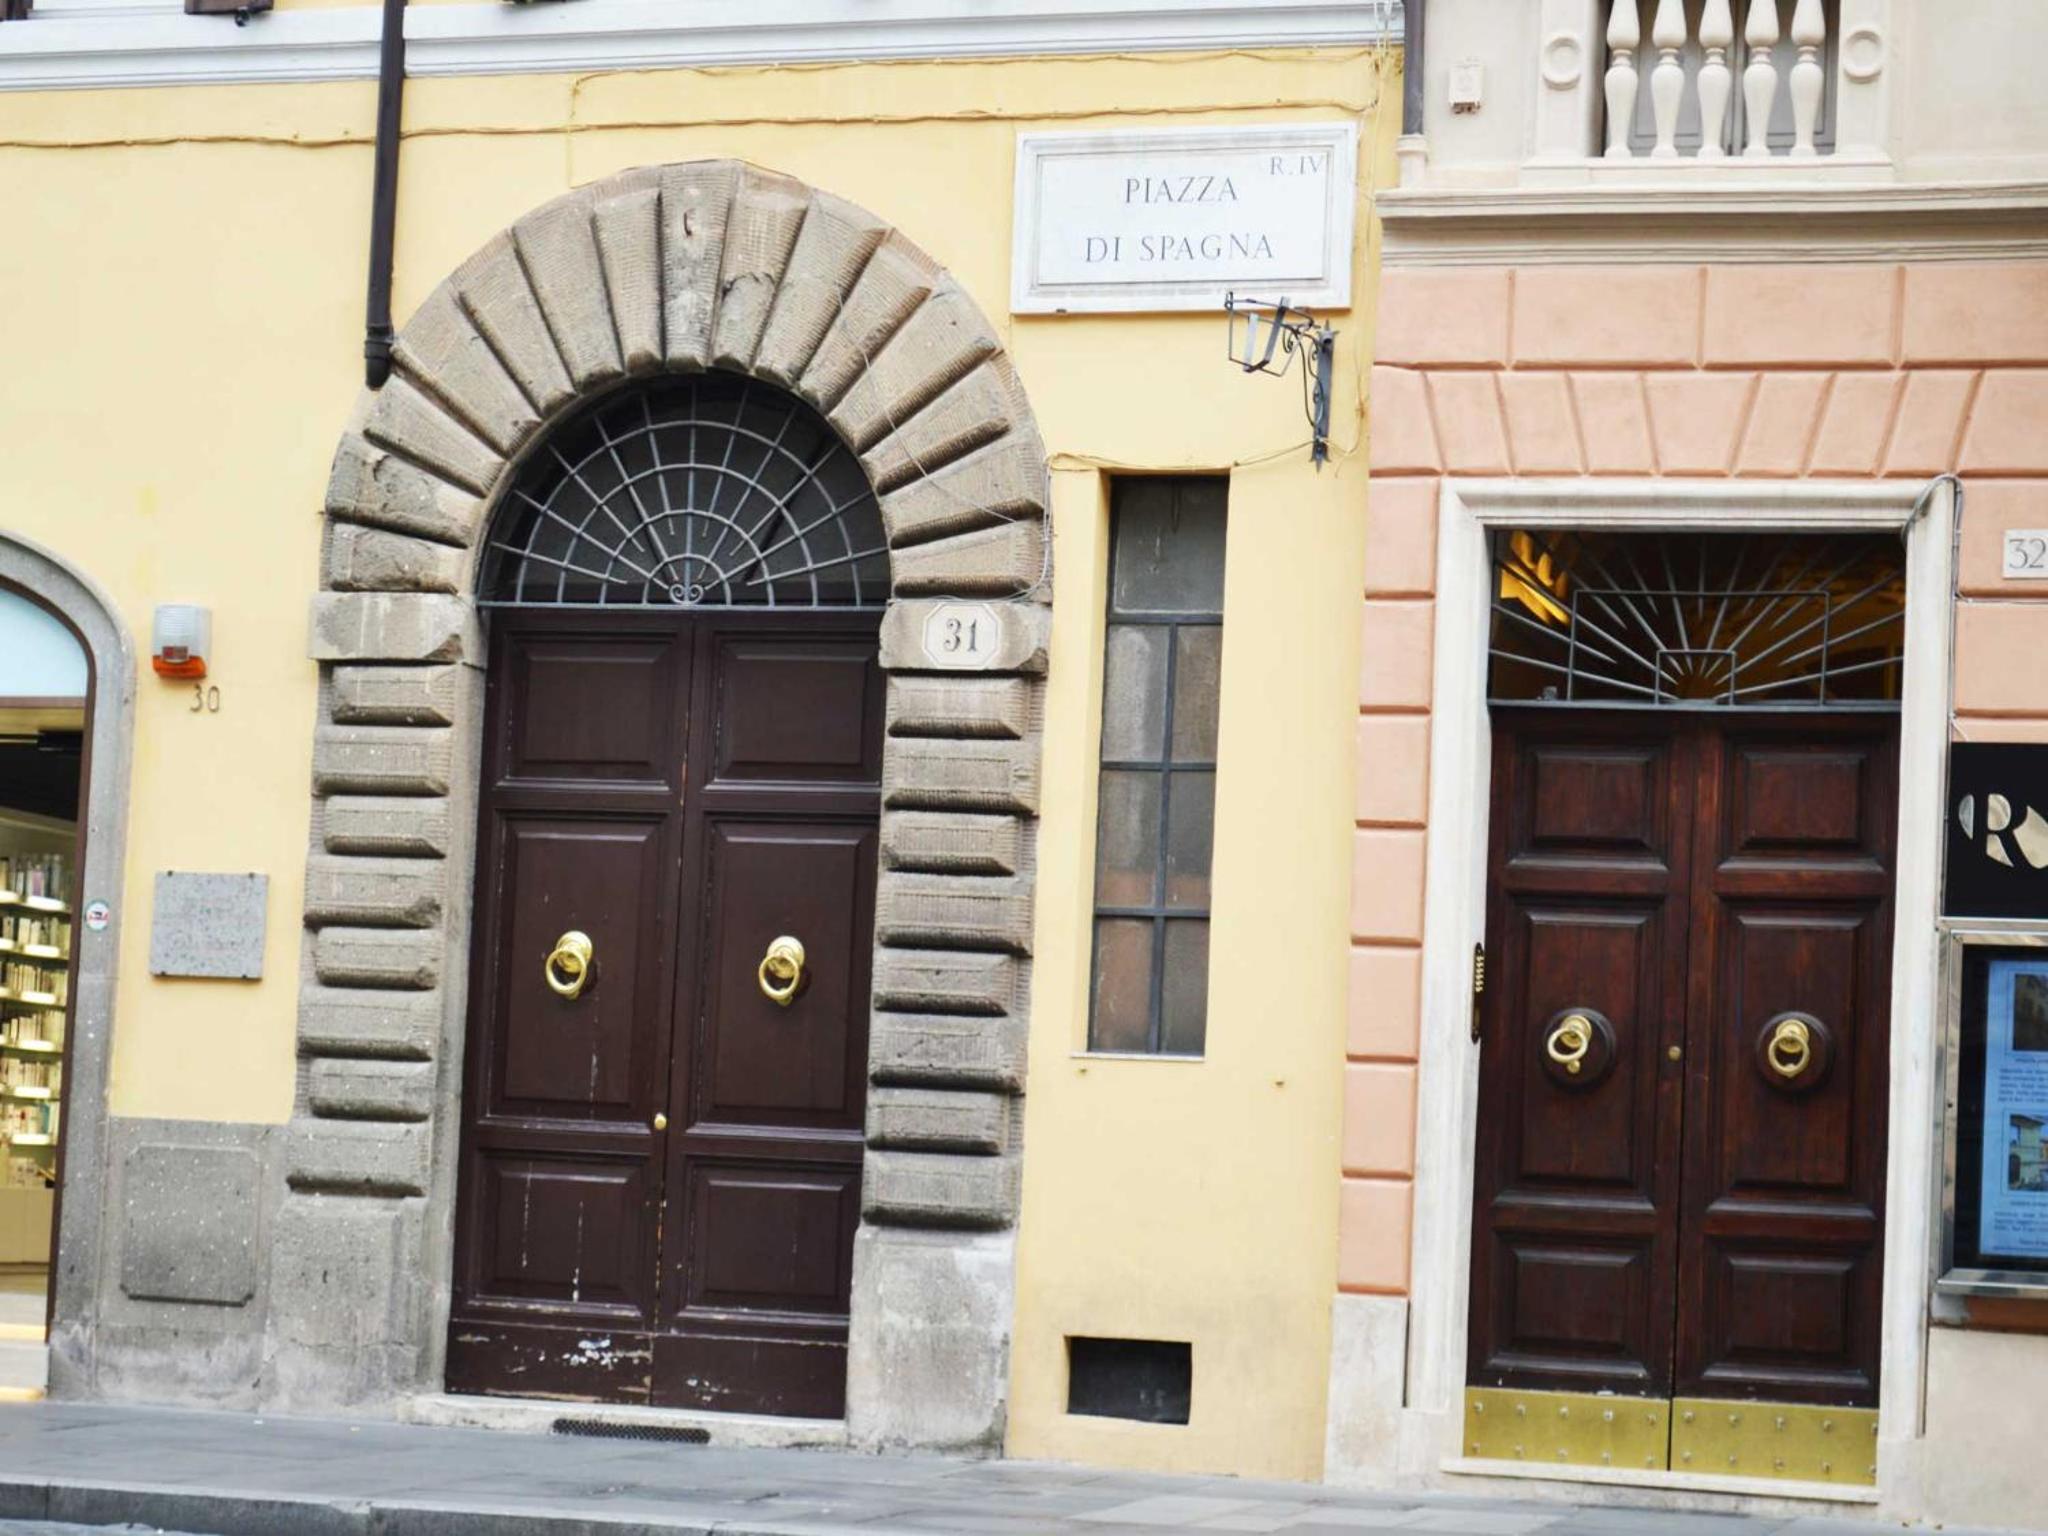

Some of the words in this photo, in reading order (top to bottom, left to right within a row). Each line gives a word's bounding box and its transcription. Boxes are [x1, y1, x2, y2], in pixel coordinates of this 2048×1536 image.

[1300, 155, 1324, 175] IV
[1125, 176, 1239, 204] PIAZZA
[1085, 236, 1120, 263] DI
[1139, 233, 1274, 262] SPAGNA
[2008, 538, 2047, 569] 32
[943, 618, 977, 652] 31
[189, 683, 220, 713] 30
